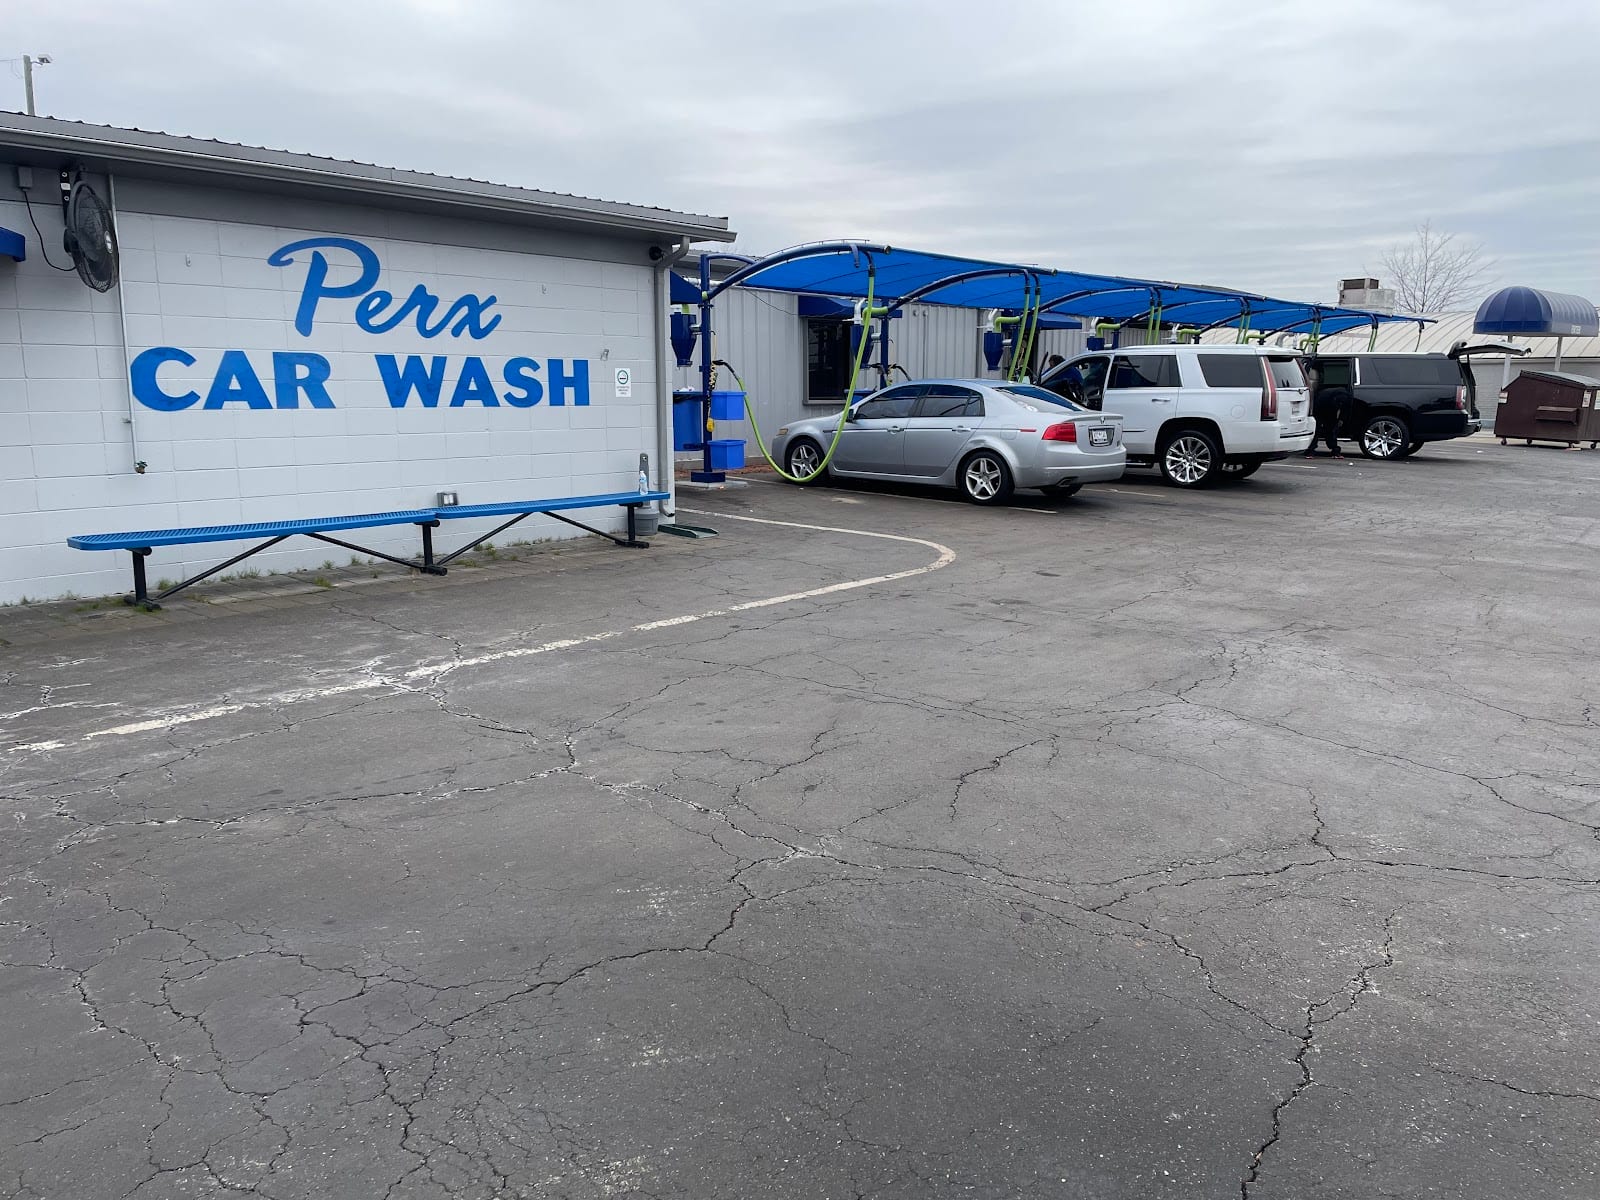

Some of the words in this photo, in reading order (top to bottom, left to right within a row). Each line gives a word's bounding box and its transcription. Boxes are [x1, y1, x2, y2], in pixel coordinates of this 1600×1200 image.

[268, 237, 502, 341] Perx
[130, 345, 336, 412] CAR
[374, 353, 591, 410] WASH
